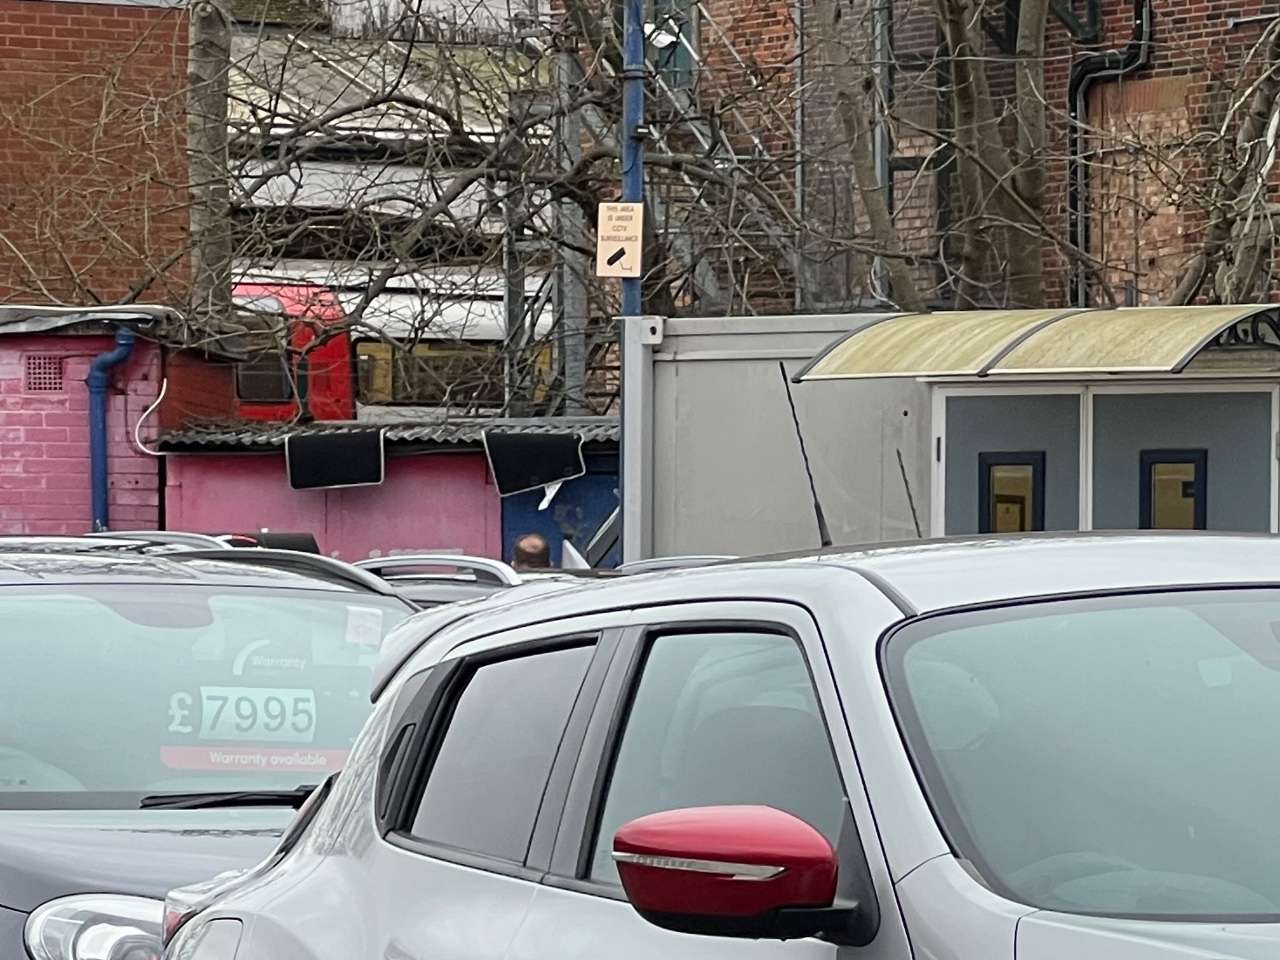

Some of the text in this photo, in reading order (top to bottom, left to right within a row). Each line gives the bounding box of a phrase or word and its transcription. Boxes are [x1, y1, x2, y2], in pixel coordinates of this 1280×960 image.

[252, 656, 306, 671] Warranty
[209, 751, 328, 766] Warranty available
